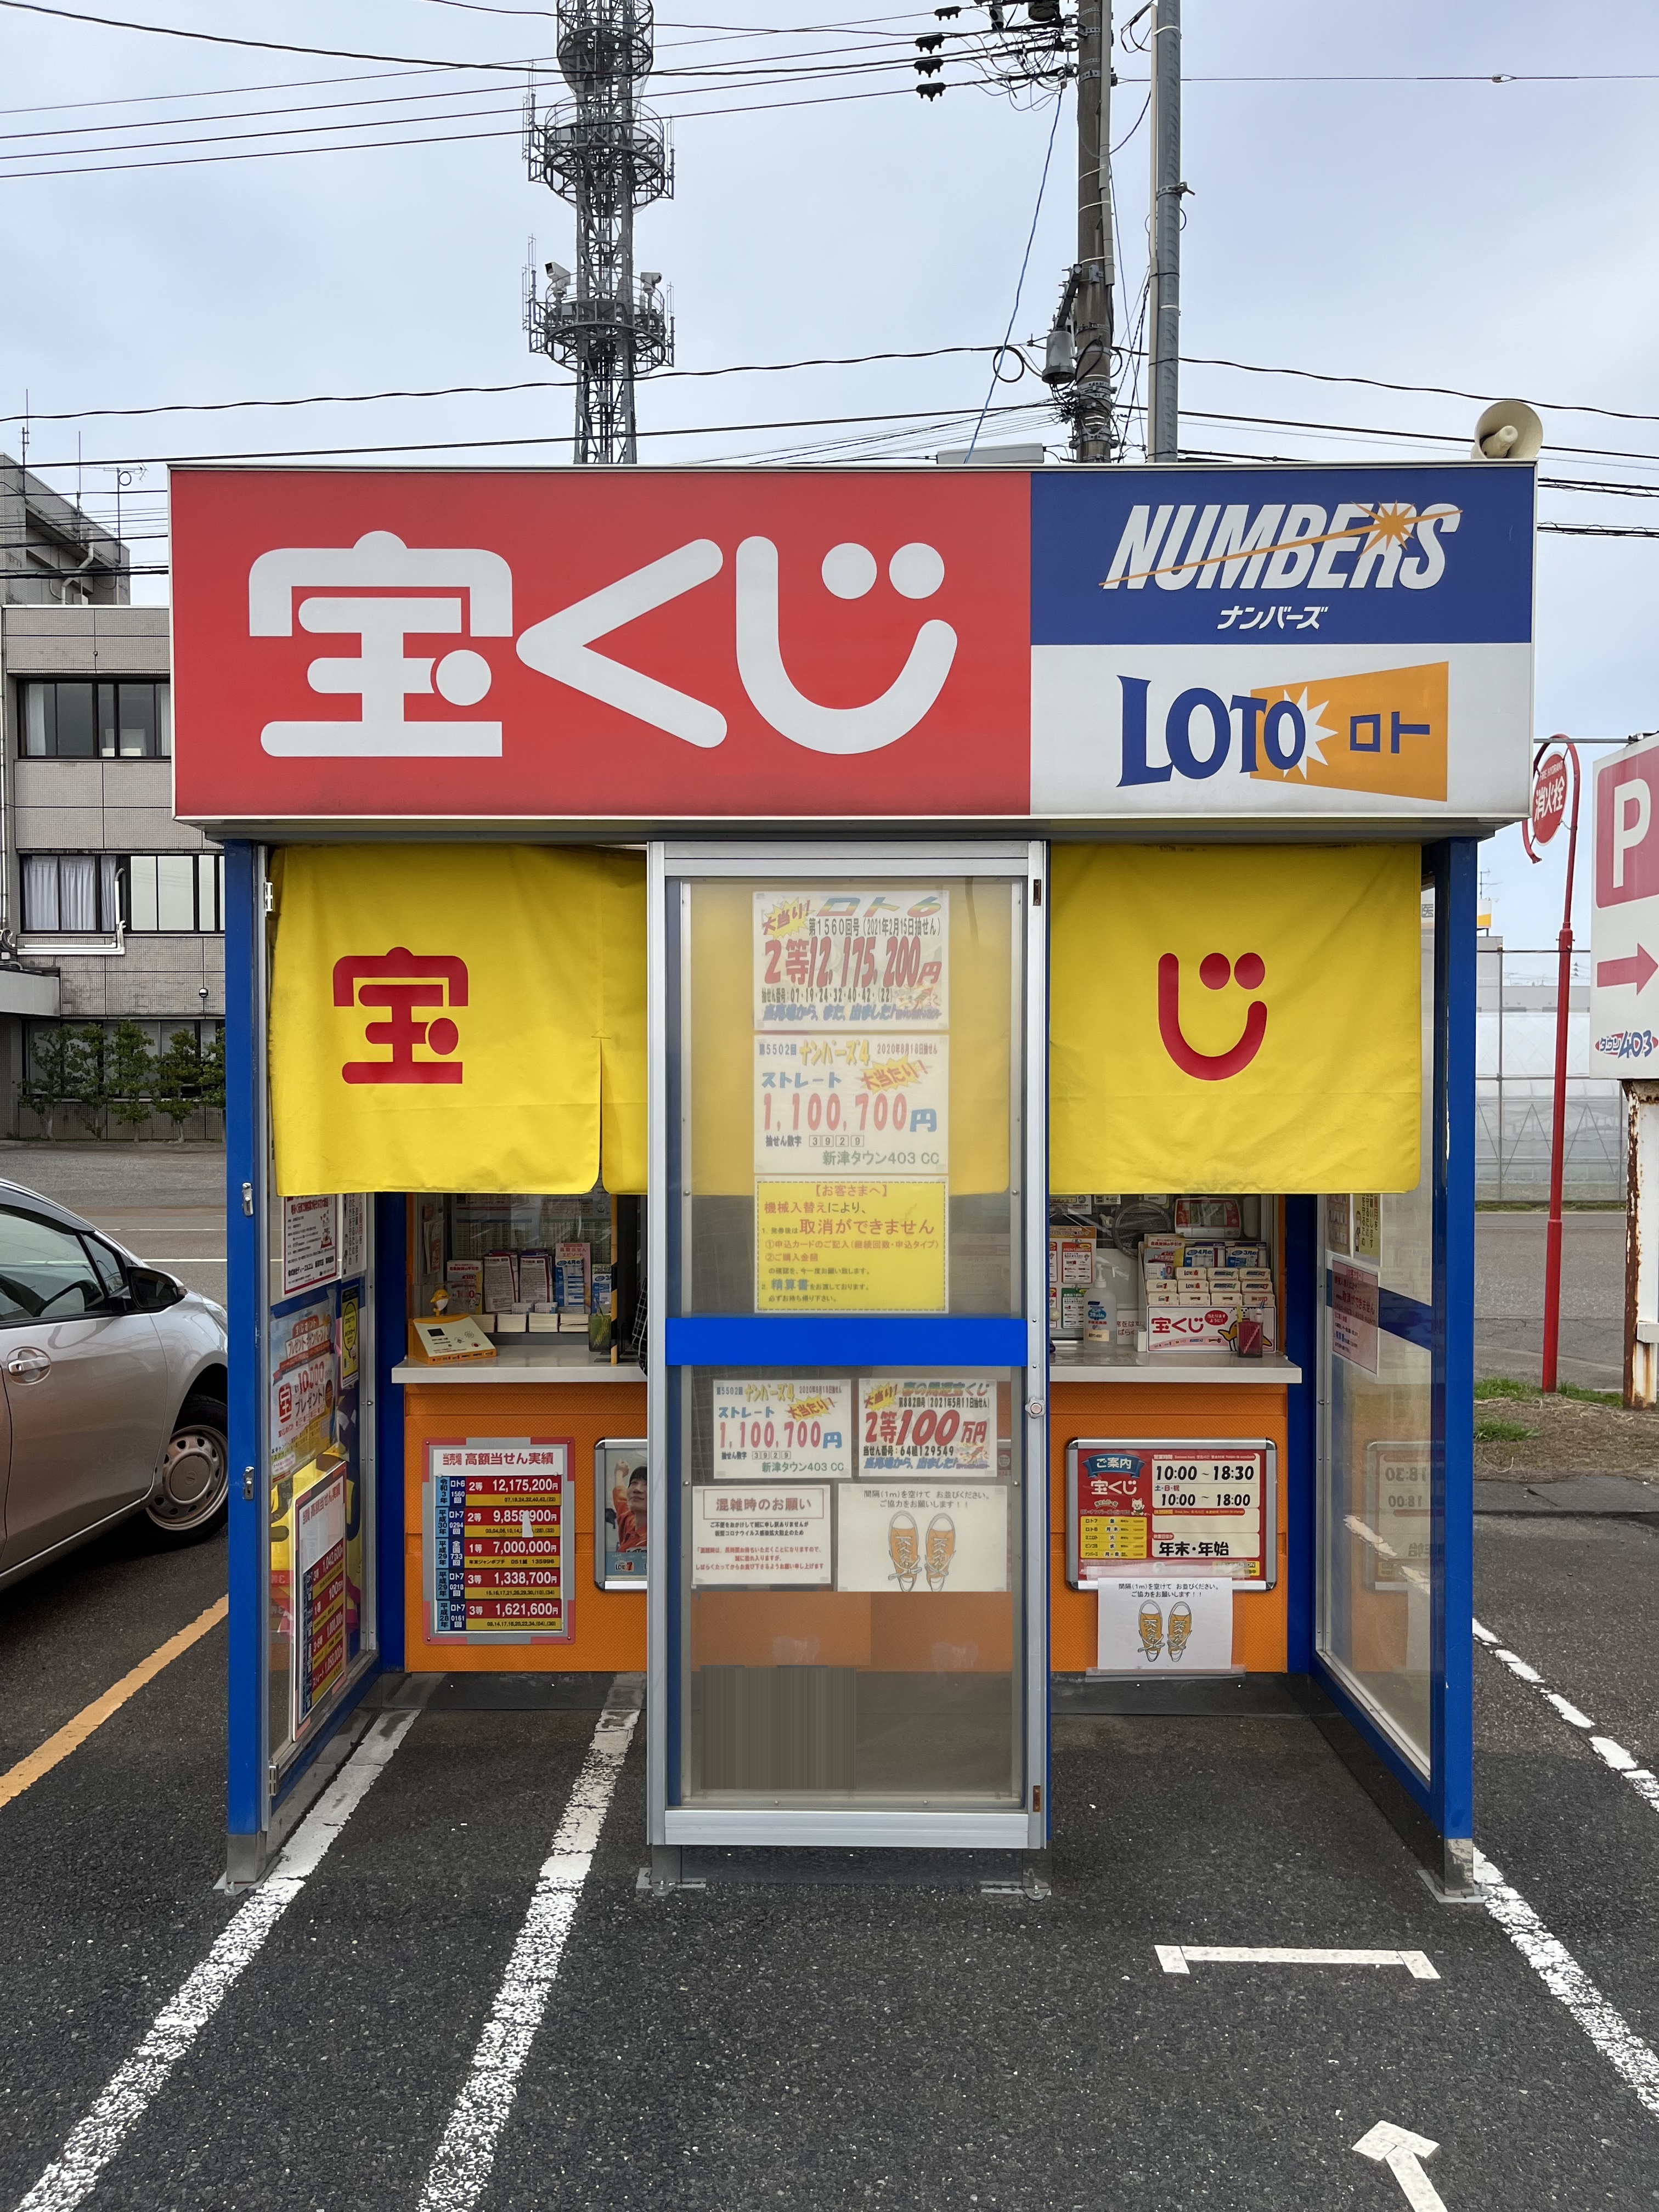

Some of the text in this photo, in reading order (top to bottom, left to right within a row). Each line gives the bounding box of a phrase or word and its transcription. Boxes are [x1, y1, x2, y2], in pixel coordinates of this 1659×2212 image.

[1102, 501, 1463, 591] NUMBERS
[1216, 605, 1328, 630] ナンバーズ
[249, 531, 957, 757] 宝くじ
[1115, 675, 1306, 788] LOTO
[1350, 711, 1431, 754] ロト
[1534, 775, 1565, 822] 消火栓
[1612, 778, 1652, 889] P
[816, 896, 942, 918] ロト6
[332, 946, 469, 1085] 宝
[759, 1043, 797, 1056] 第5502回
[877, 1043, 938, 1056] 2020年8月18日抽せん
[1600, 1030, 1653, 1059] タウン403
[799, 1039, 871, 1066] ナンバーズ4
[761, 1071, 842, 1089] ストレート
[764, 1093, 937, 1132] 1,100,700円
[822, 1150, 940, 1166] 新津タウン403 CC
[815, 1184, 888, 1197] 【お客さまへ】
[764, 1201, 867, 1214] 機械入替えにより、
[765, 1253, 819, 1262] ②ご購入金額
[1151, 1317, 1204, 1333] 宝くじ
[744, 1383, 795, 1402] ナンバーズ4
[718, 1406, 775, 1419] ストレート
[720, 1421, 843, 1449] 1,100,700円
[465, 1452, 554, 1465] 高額当せん実績
[1096, 1457, 1132, 1470] ご案内
[761, 1462, 844, 1472] 新津タウン403 CC
[1156, 1465, 1197, 1481] 10:00
[1214, 1465, 1254, 1481] 18:30
[450, 1480, 465, 1488] ロト6
[492, 1479, 558, 1493] 12,175,200円
[1091, 1479, 1137, 1496] 宝くじ
[864, 1490, 990, 1500] 間隔(1m)を空けて お並びください。
[1161, 1493, 1196, 1506] 10:00
[1217, 1494, 1251, 1506] 18:00
[715, 1497, 812, 1512] 混雑時のお願い
[493, 1509, 557, 1523] 9,858900円
[493, 1541, 557, 1555] 7,000,000円
[1159, 1541, 1229, 1556] 年末・年始
[449, 1572, 464, 1581] ロト7
[494, 1572, 557, 1585] 1,338,700円
[495, 1603, 558, 1617] 1,621,600円
